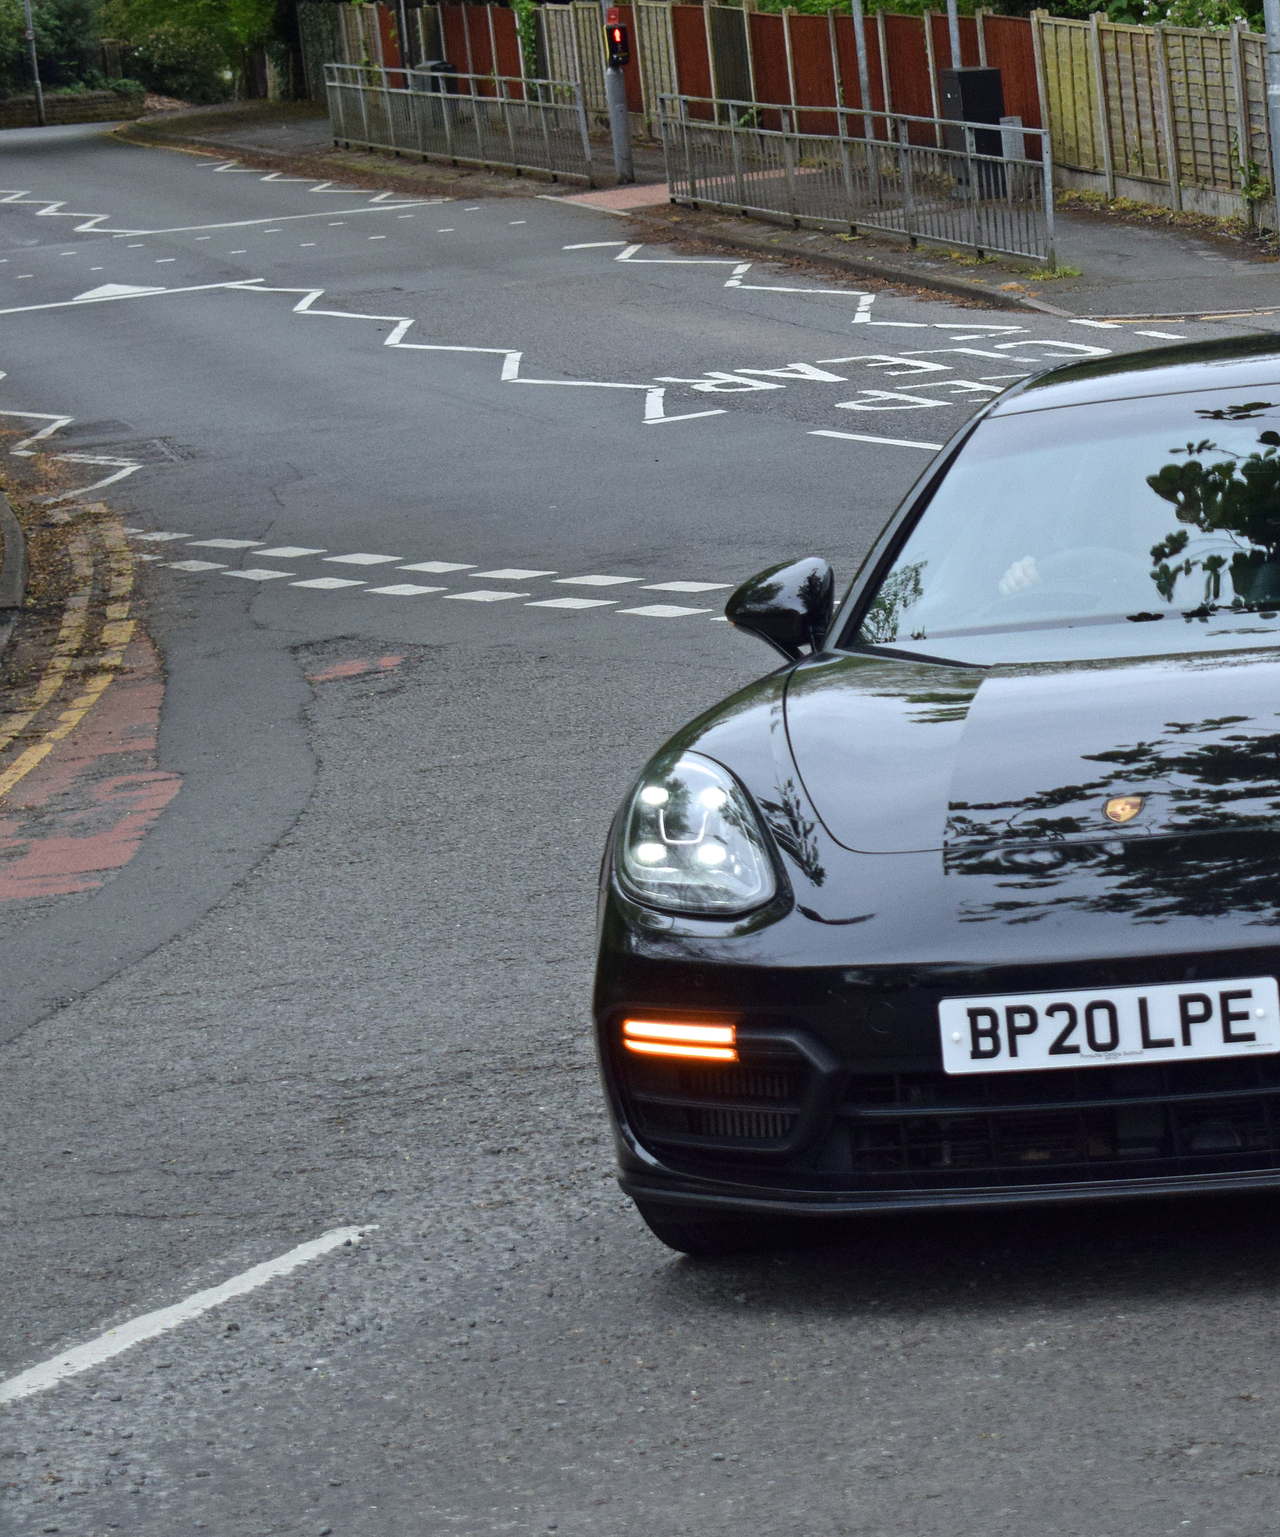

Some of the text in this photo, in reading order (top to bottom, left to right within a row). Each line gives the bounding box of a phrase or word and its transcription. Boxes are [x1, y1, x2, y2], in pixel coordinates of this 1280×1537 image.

[653, 339, 1113, 394] CLEAR
[966, 988, 1257, 1060] BP20 LPE
